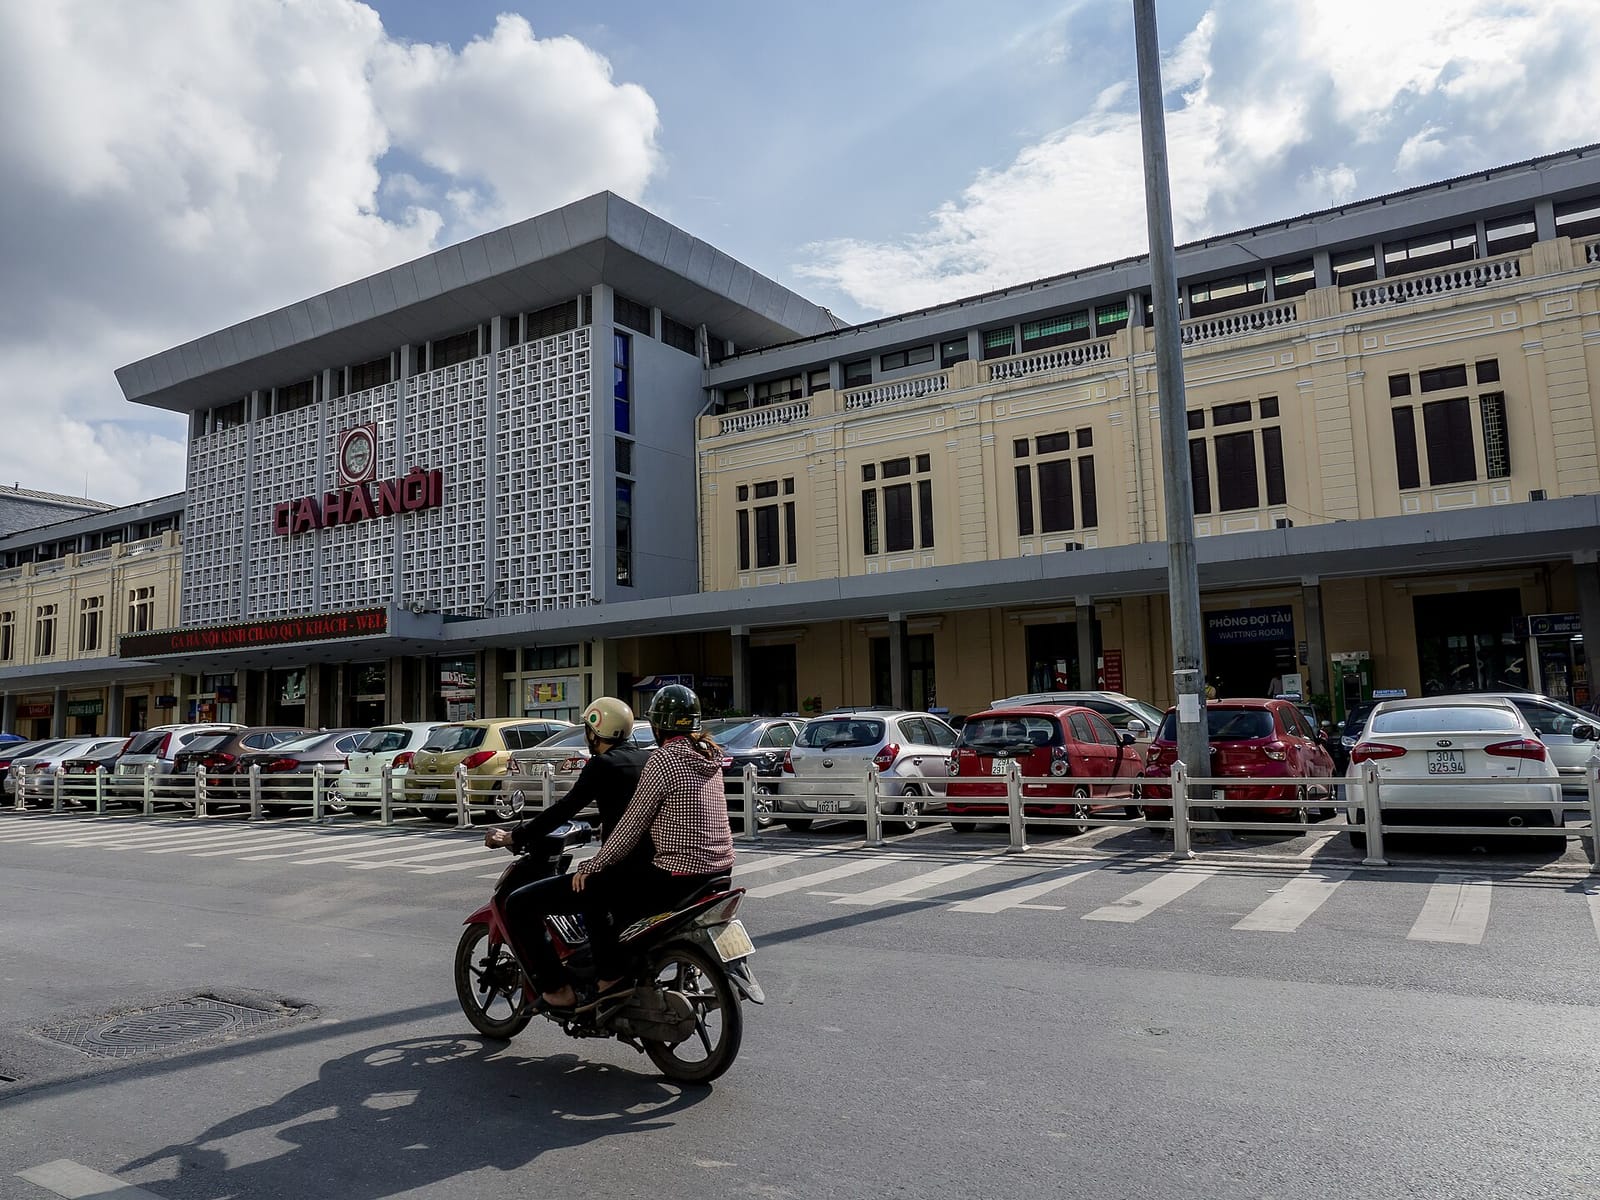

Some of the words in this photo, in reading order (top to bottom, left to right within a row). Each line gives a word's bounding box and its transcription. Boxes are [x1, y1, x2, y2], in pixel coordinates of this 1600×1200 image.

[275, 497, 323, 536] GA
[1208, 615, 1249, 629] PHÒNG
[1249, 614, 1270, 627] ĐỢI
[1271, 611, 1292, 624] TÀU
[171, 634, 185, 649] GA
[305, 614, 349, 635] KHÁCH
[1218, 630, 1257, 639] WAITTING
[1258, 627, 1284, 638] ROOM
[1436, 749, 1456, 761] 30A
[1430, 761, 1463, 772] 325.94
